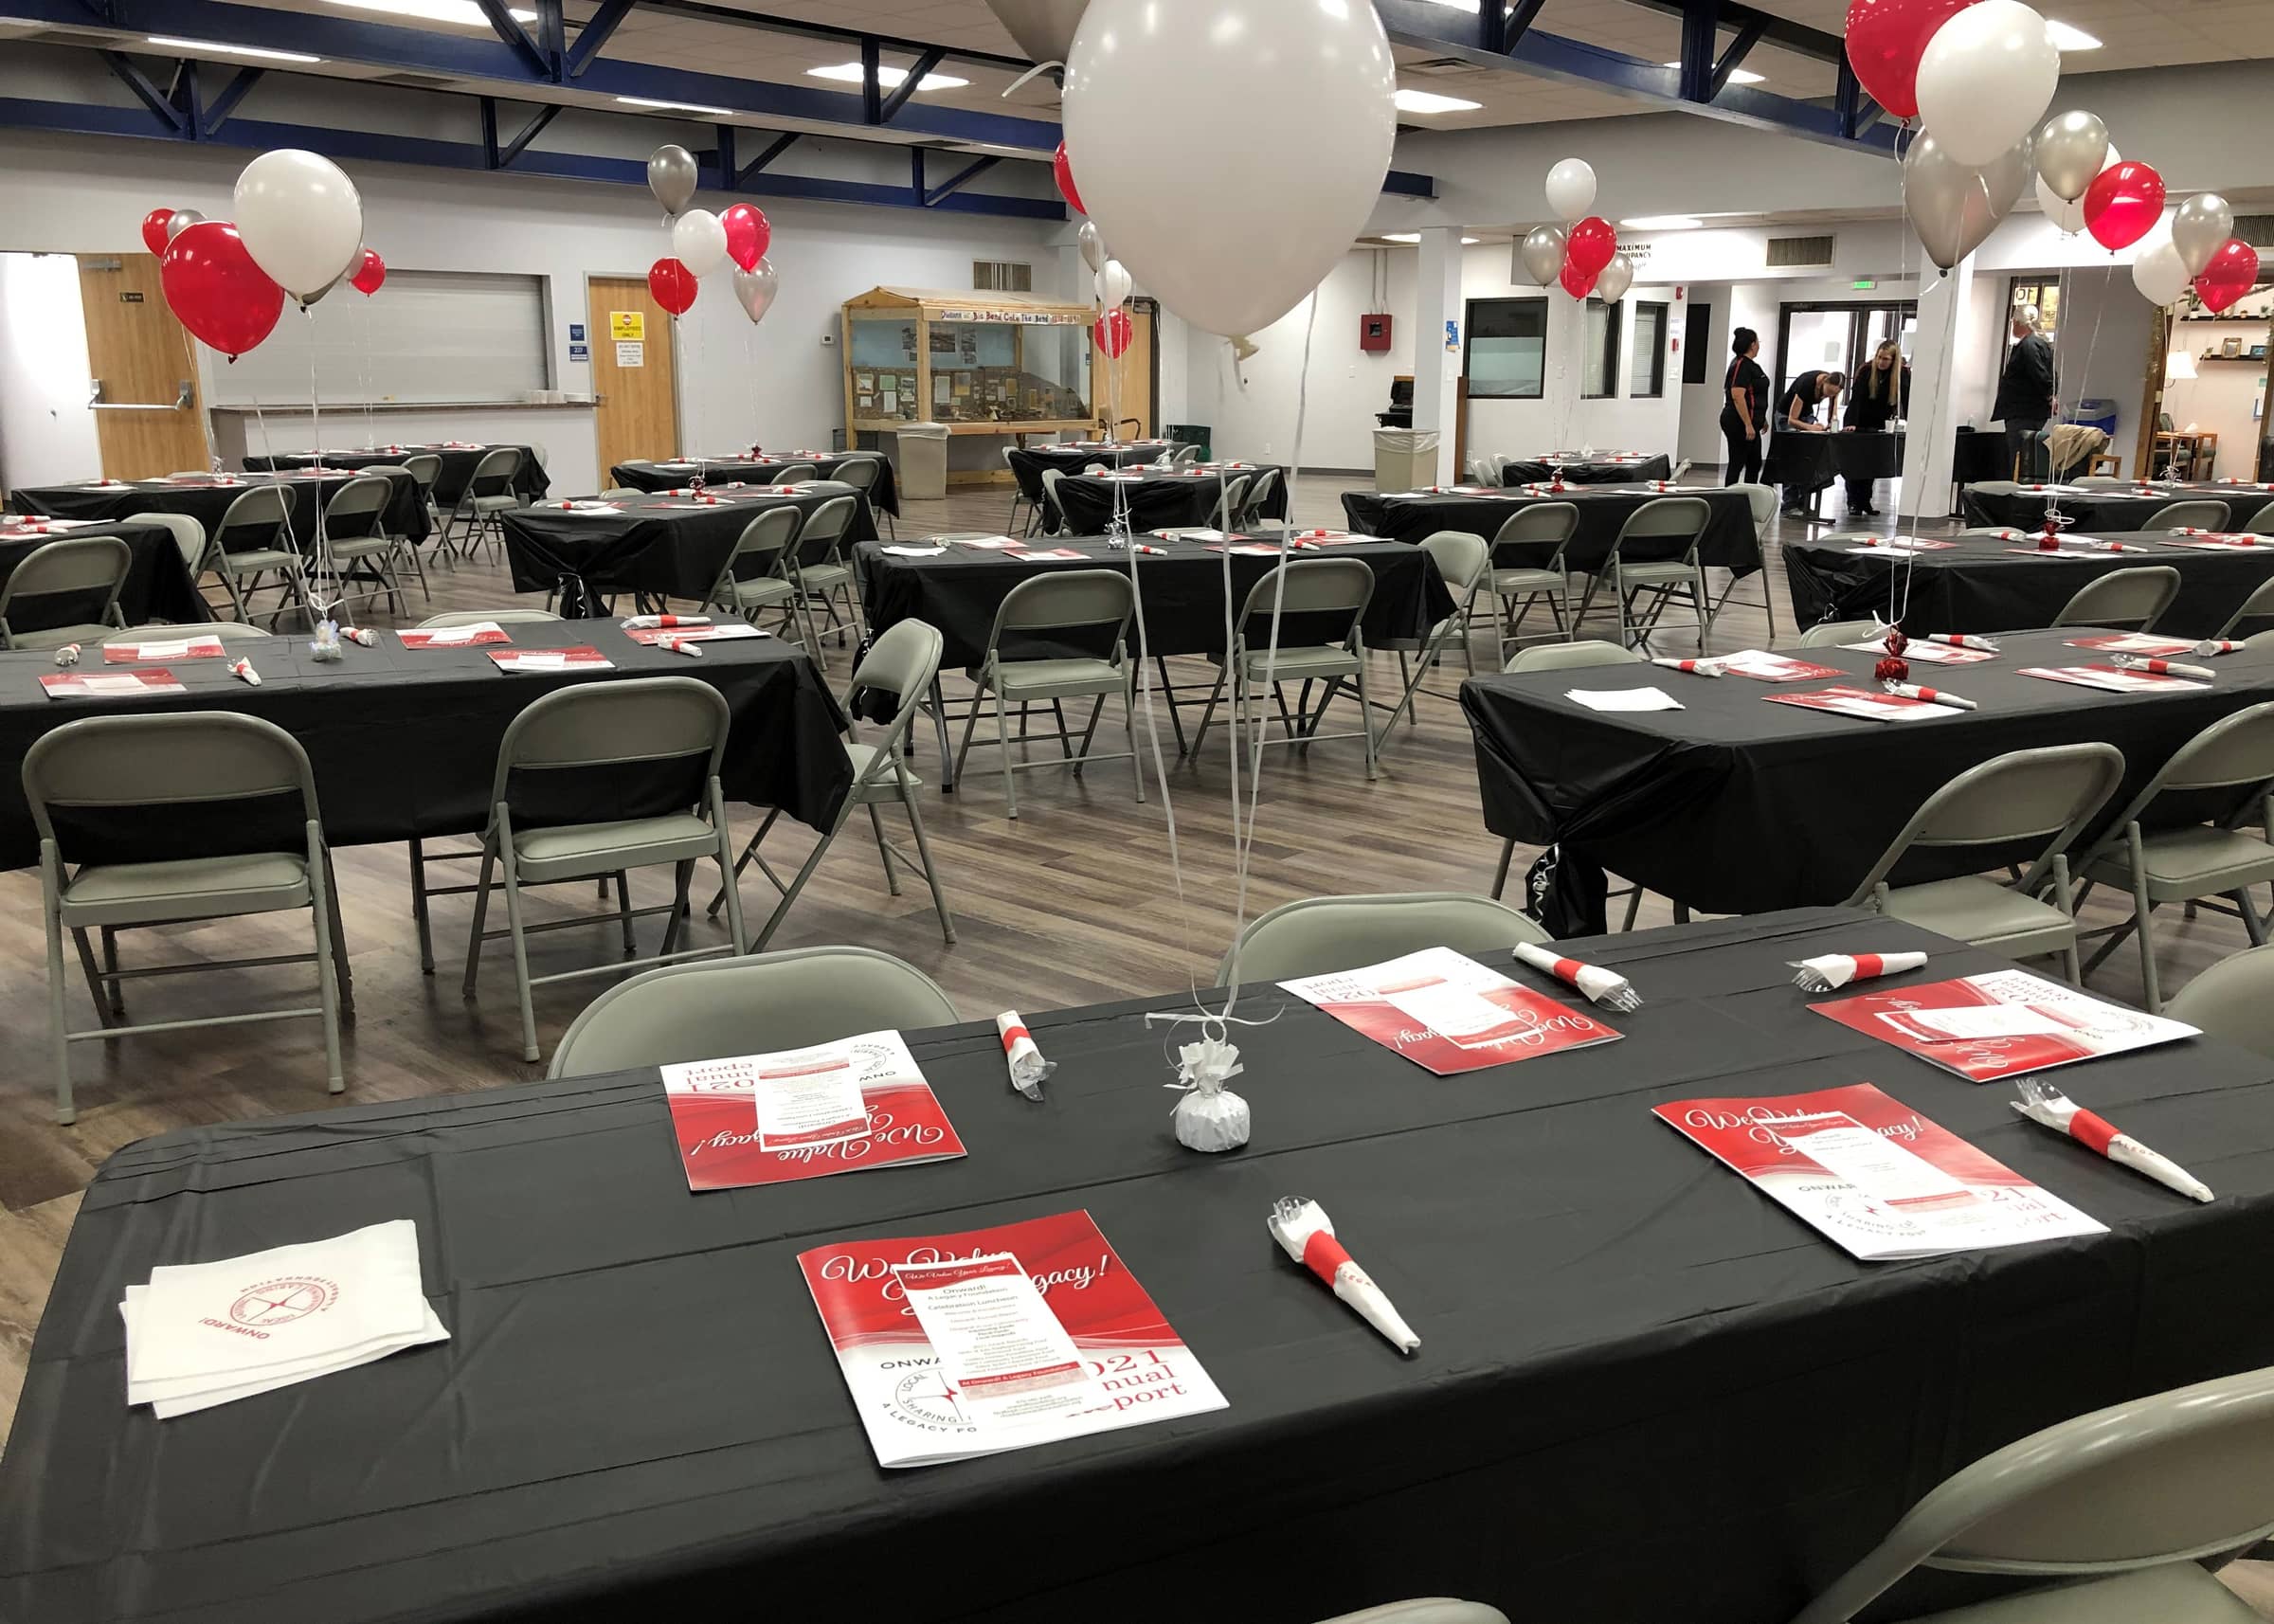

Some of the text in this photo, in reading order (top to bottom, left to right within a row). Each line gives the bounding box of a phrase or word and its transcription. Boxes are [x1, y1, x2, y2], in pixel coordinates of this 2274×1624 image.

[1616, 244, 1651, 252] MAXIMUM
[688, 1064, 753, 1076] eport
[692, 1080, 755, 1092] 021
[875, 1123, 945, 1146] We
[777, 1139, 872, 1164] Value
[935, 1292, 962, 1301] Legacy
[964, 1287, 1008, 1298] Foundation
[943, 1284, 986, 1294] Onward!
[928, 1301, 976, 1310] Celebration
[198, 1318, 271, 1340] ONWARD!
[902, 1397, 957, 1423] SHARING
[890, 1411, 948, 1433] LEGACY
